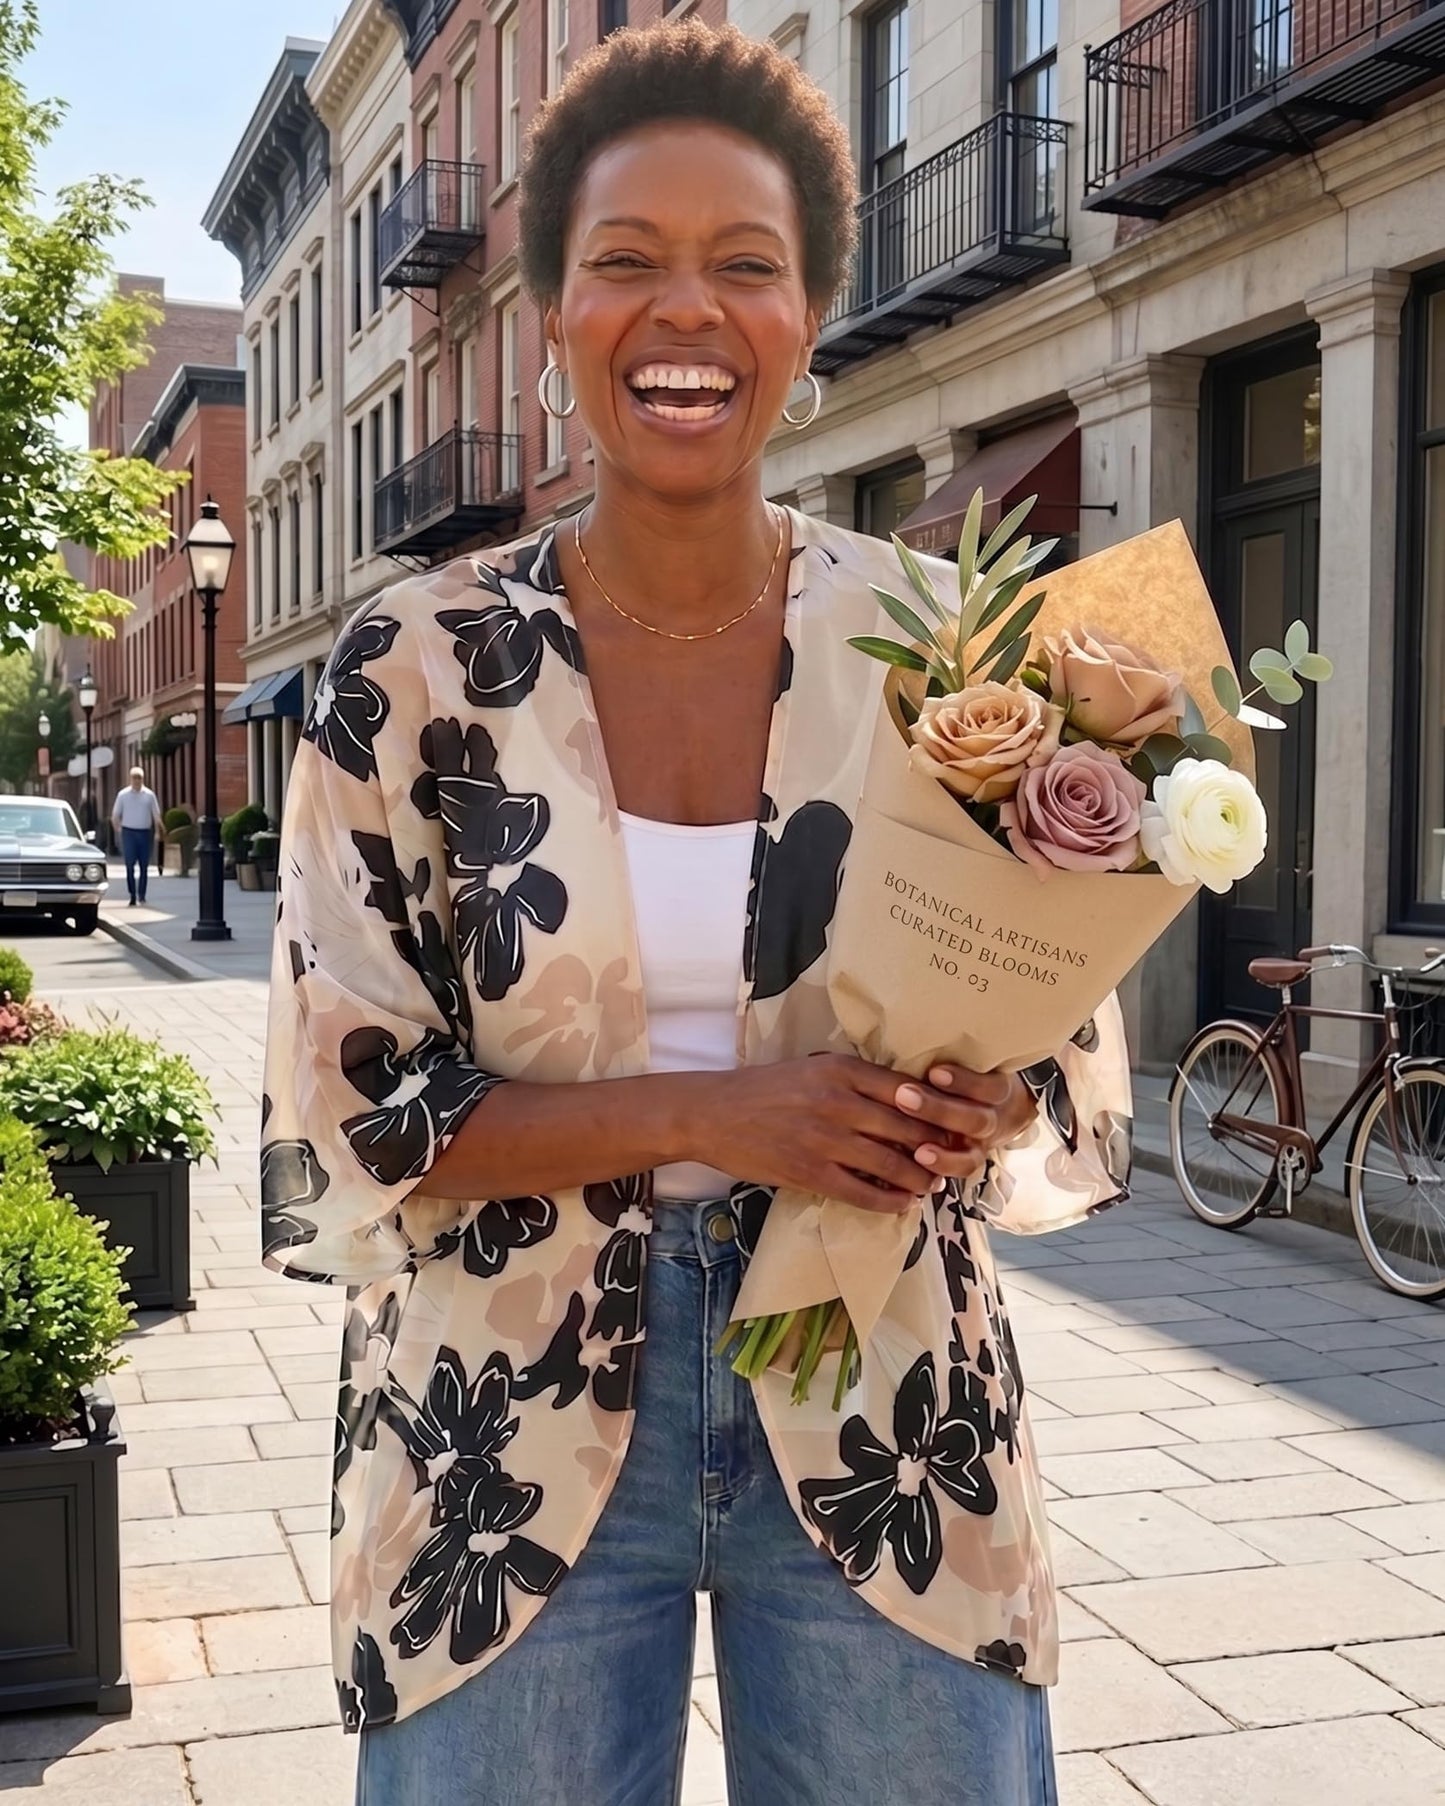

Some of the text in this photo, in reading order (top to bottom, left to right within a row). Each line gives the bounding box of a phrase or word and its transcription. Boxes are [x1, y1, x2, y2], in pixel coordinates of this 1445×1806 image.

[884, 871, 1088, 967] BOTANICAL ARTISANS
[890, 904, 1059, 986] CURATED BLOOMS
[929, 953, 989, 992] NO. 03
